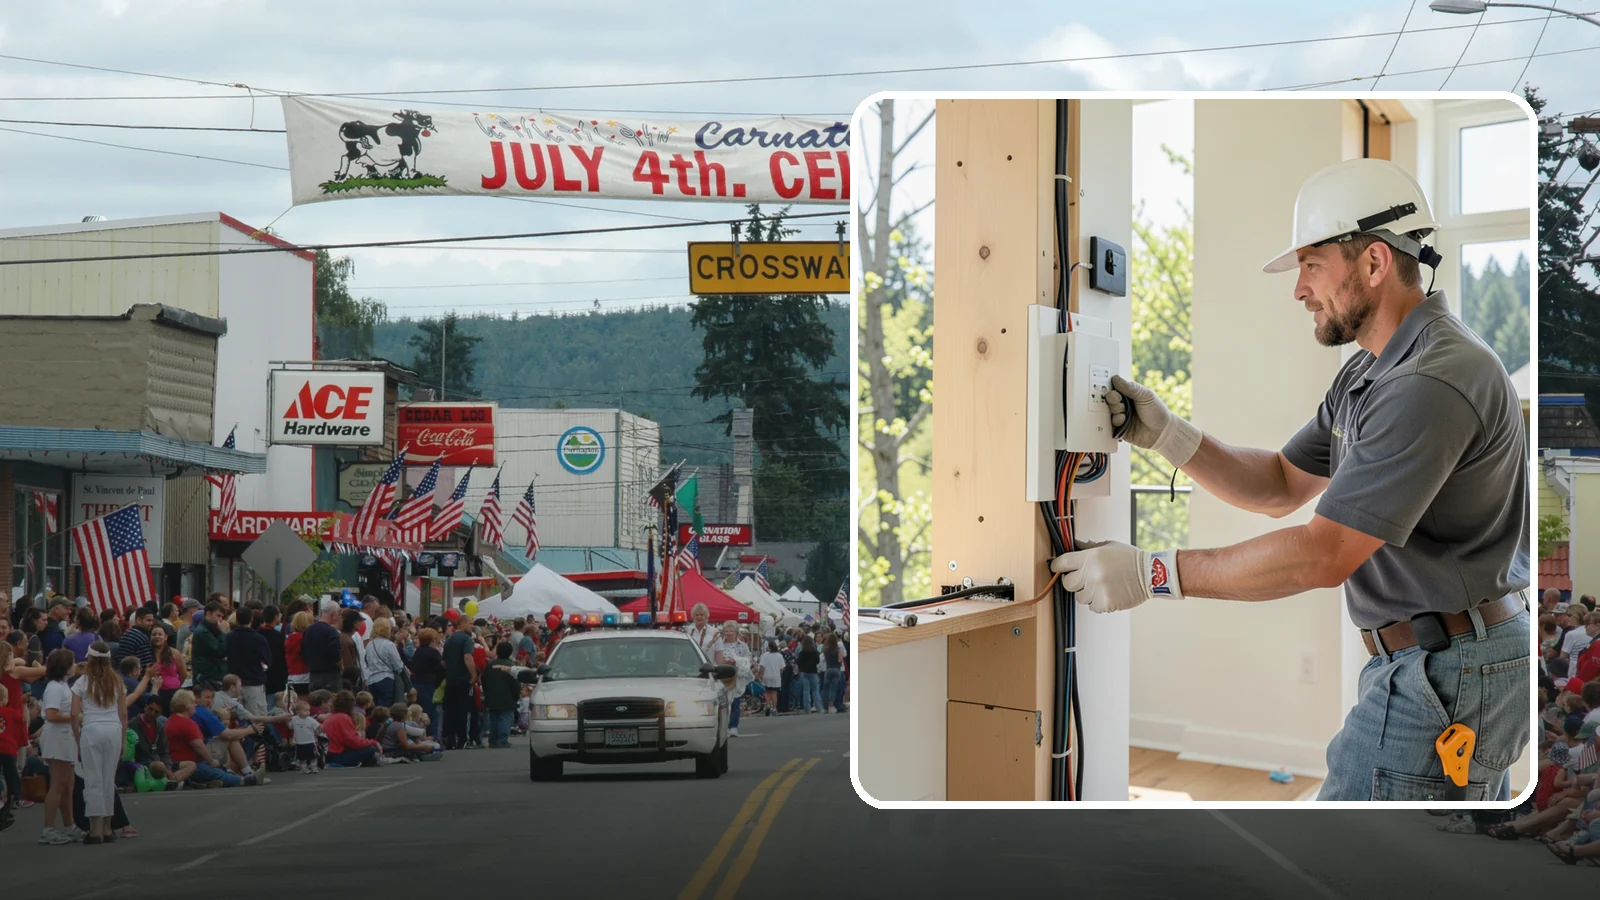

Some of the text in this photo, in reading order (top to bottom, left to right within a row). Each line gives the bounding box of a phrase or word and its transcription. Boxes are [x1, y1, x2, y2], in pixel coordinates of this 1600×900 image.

[481, 141, 605, 193] JULY
[632, 150, 746, 197] 4th.
[697, 254, 850, 280] CROSSWA
[283, 380, 373, 420] ACE
[283, 421, 371, 437] Hardware
[95, 484, 125, 495] Vincent
[126, 485, 136, 495] de
[138, 485, 156, 496] Paul
[688, 526, 741, 535] CRNATION
